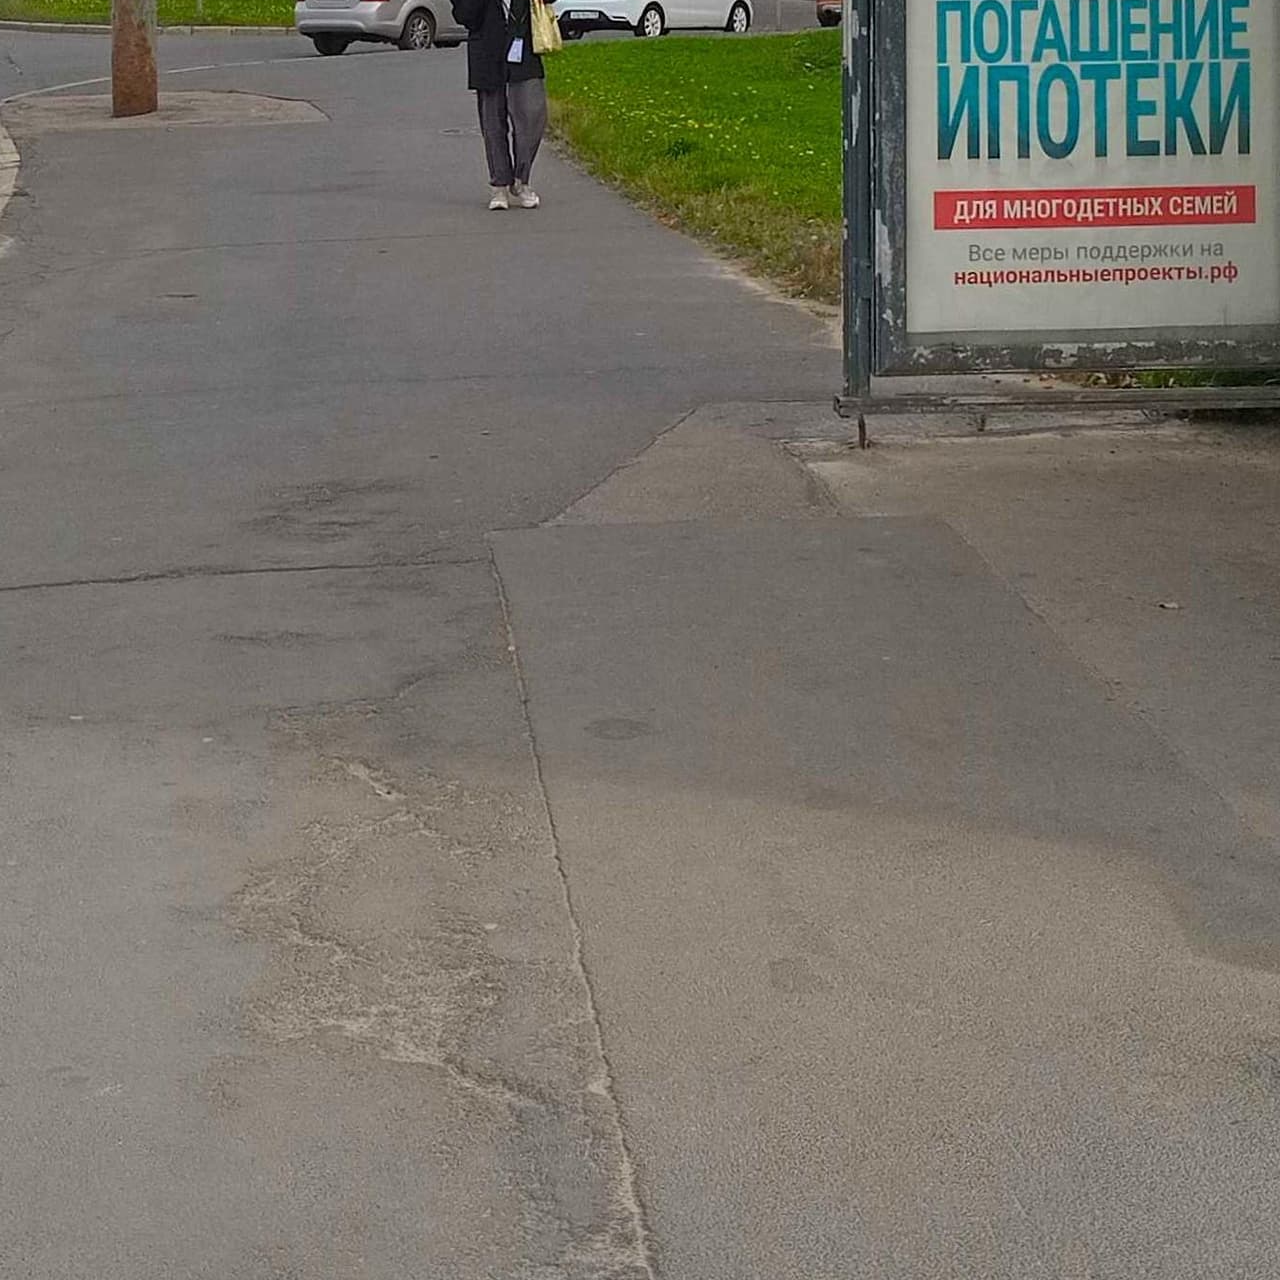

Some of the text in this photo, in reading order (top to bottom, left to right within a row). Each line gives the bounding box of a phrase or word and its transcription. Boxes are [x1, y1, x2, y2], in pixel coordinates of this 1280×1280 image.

[937, 62, 1251, 161] ИПОТЕКИ
[953, 191, 1238, 224] ДЛЯ МНОГОДЕТНЫХ СЕМЕЙ
[968, 241, 1225, 265] Все меры поддержки на
[953, 261, 1239, 288] национальныепроекты.рф
